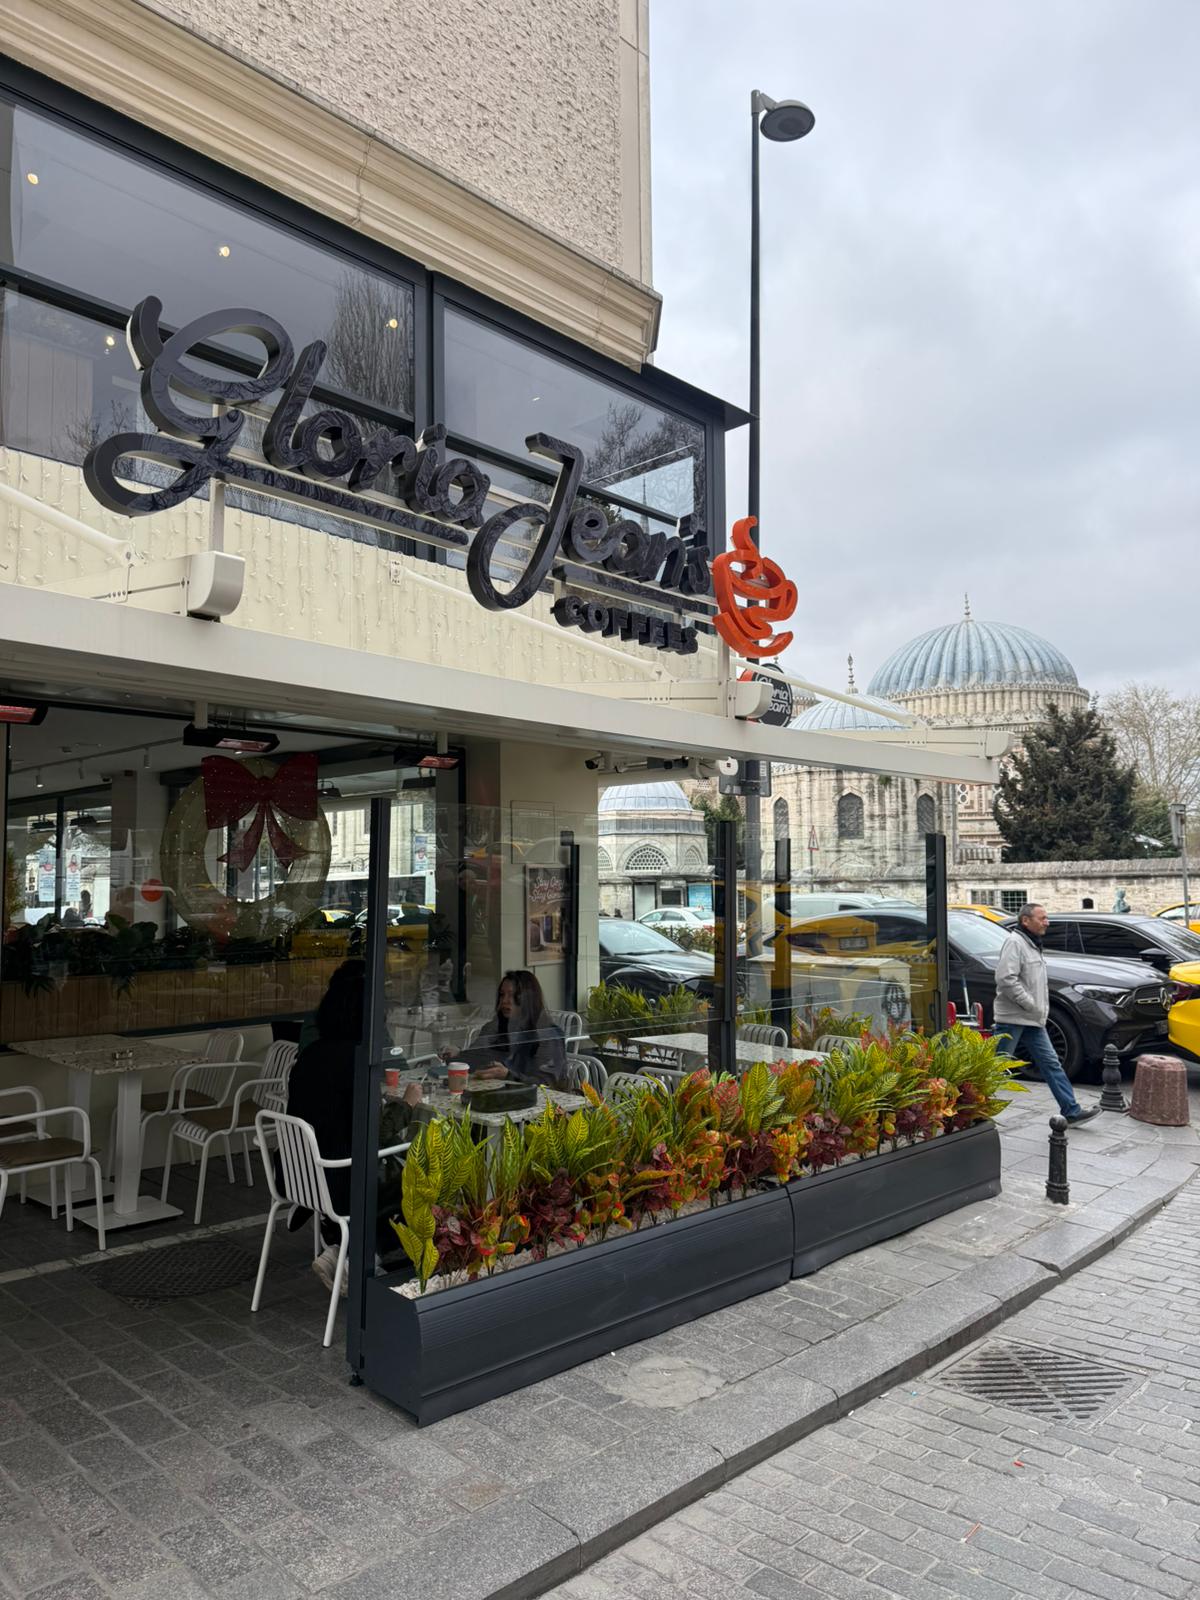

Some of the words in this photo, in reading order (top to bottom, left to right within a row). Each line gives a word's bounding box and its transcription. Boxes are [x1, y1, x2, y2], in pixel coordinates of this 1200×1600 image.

[84, 295, 491, 547] Gloria
[467, 432, 711, 612] Jean's
[551, 595, 699, 655] COFFEES
[768, 702, 791, 715] ean's
